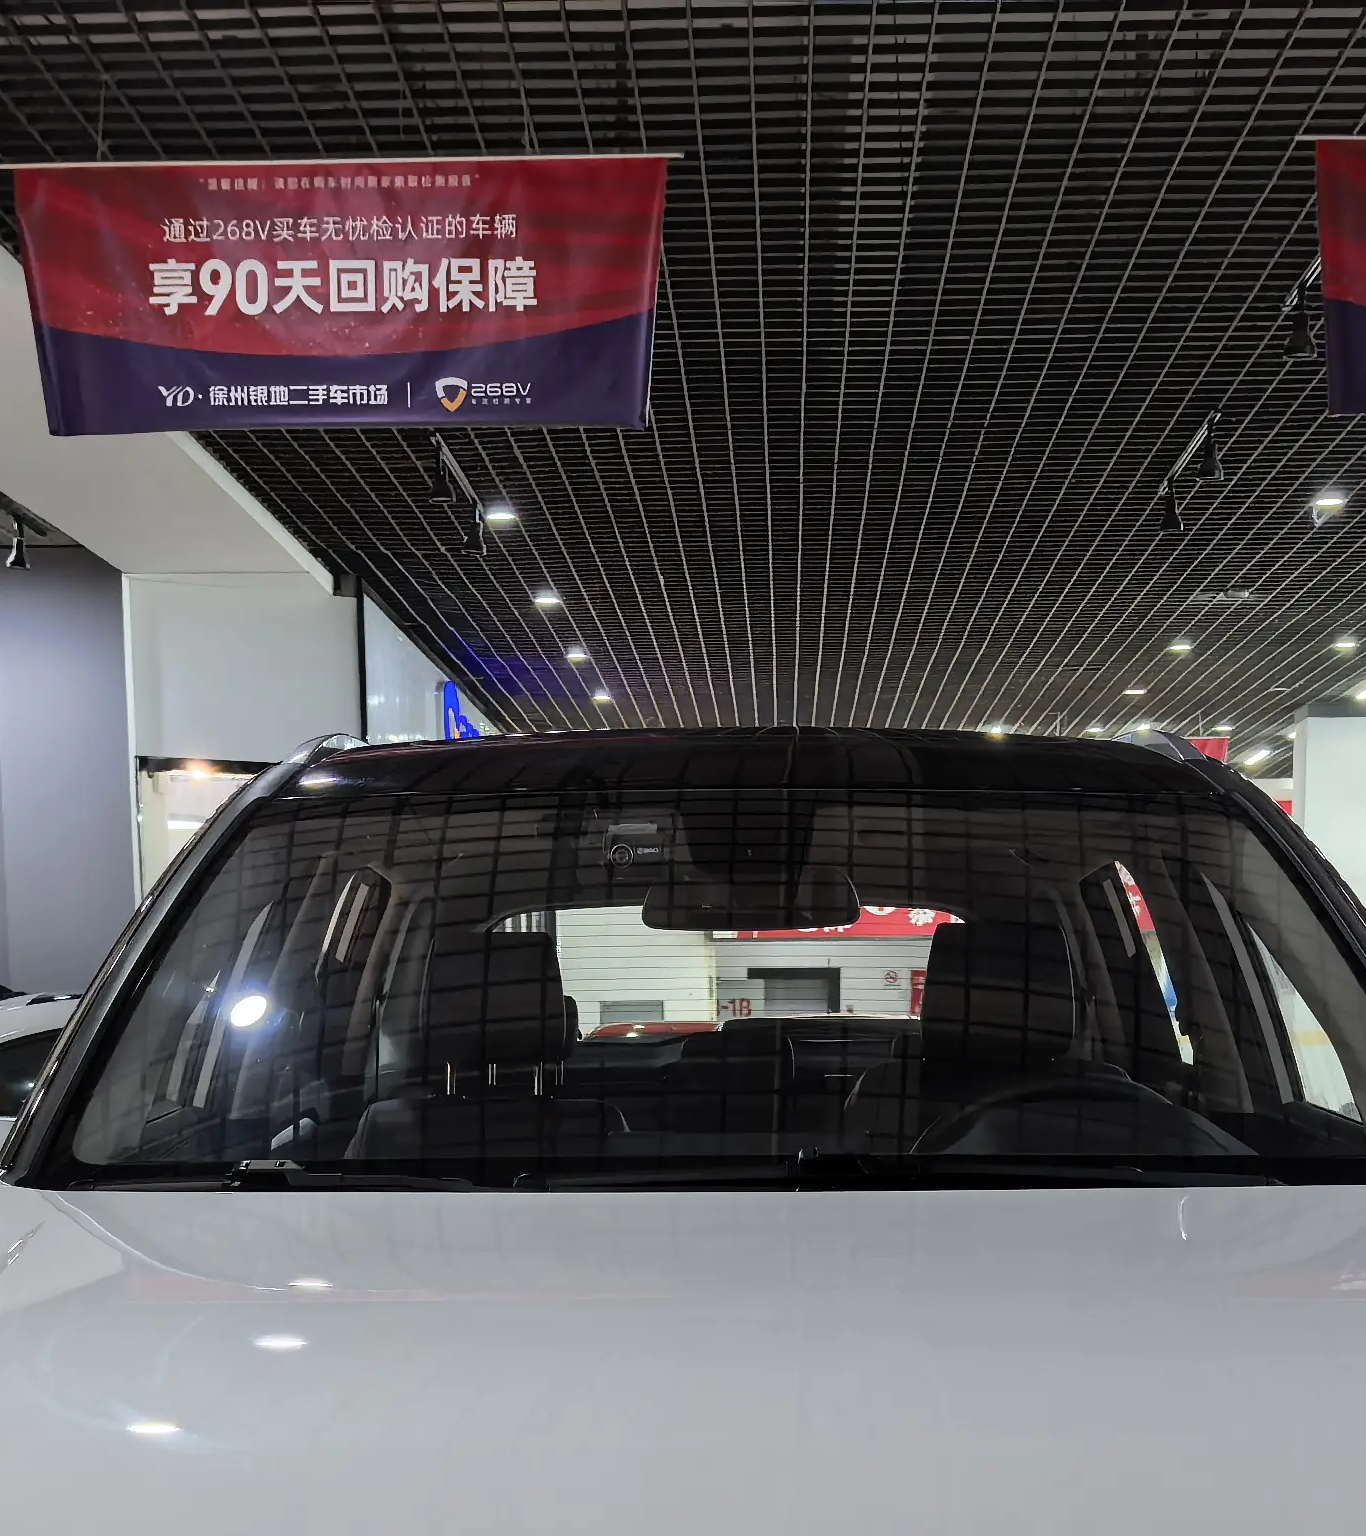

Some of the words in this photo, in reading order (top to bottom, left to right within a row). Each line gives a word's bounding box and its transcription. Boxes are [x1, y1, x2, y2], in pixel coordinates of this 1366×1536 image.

[162, 214, 518, 243] 通过268V买车无忧检认证的车辆
[149, 256, 539, 316] 享90天回购保障
[471, 382, 532, 396] 268V
